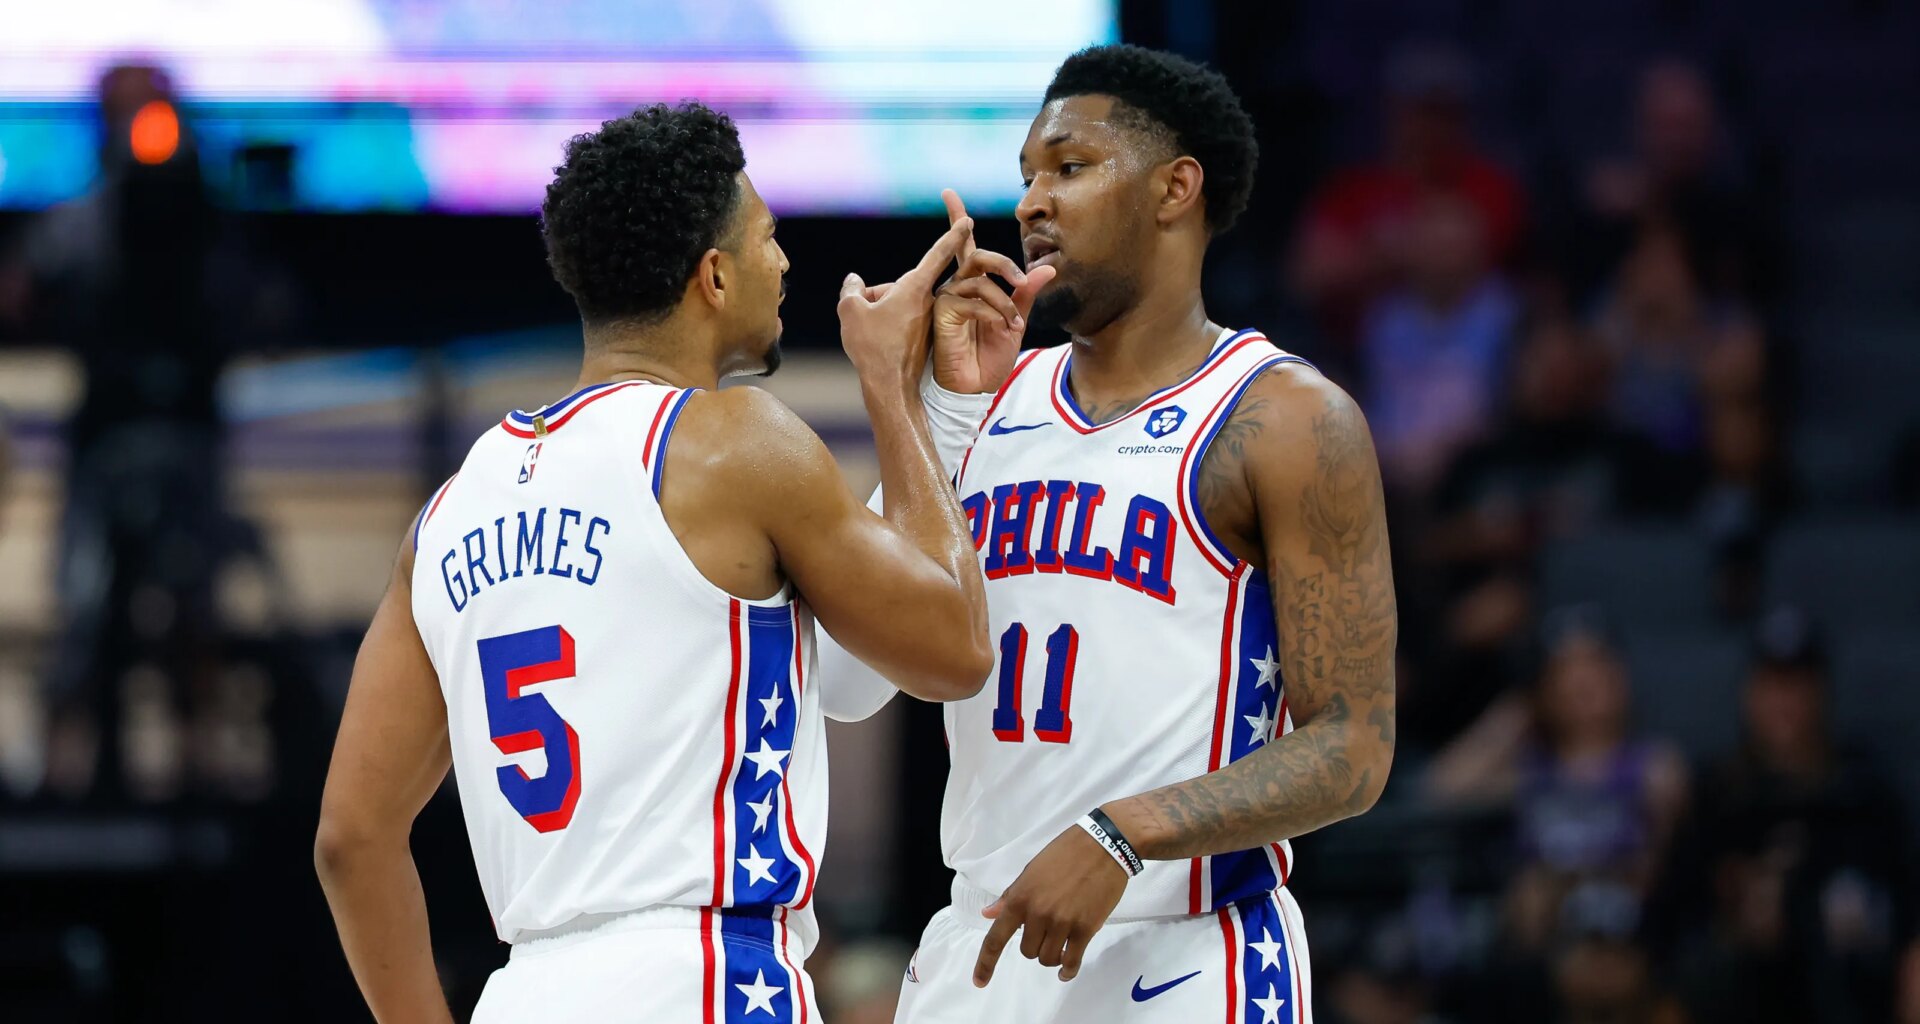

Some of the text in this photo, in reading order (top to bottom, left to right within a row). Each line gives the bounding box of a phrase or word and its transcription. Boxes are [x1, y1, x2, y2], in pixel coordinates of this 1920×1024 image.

[1118, 445, 1184, 455] crypto.com
[441, 507, 610, 612] GRIMES
[477, 624, 582, 833] 5
[992, 622, 1079, 743] 11
